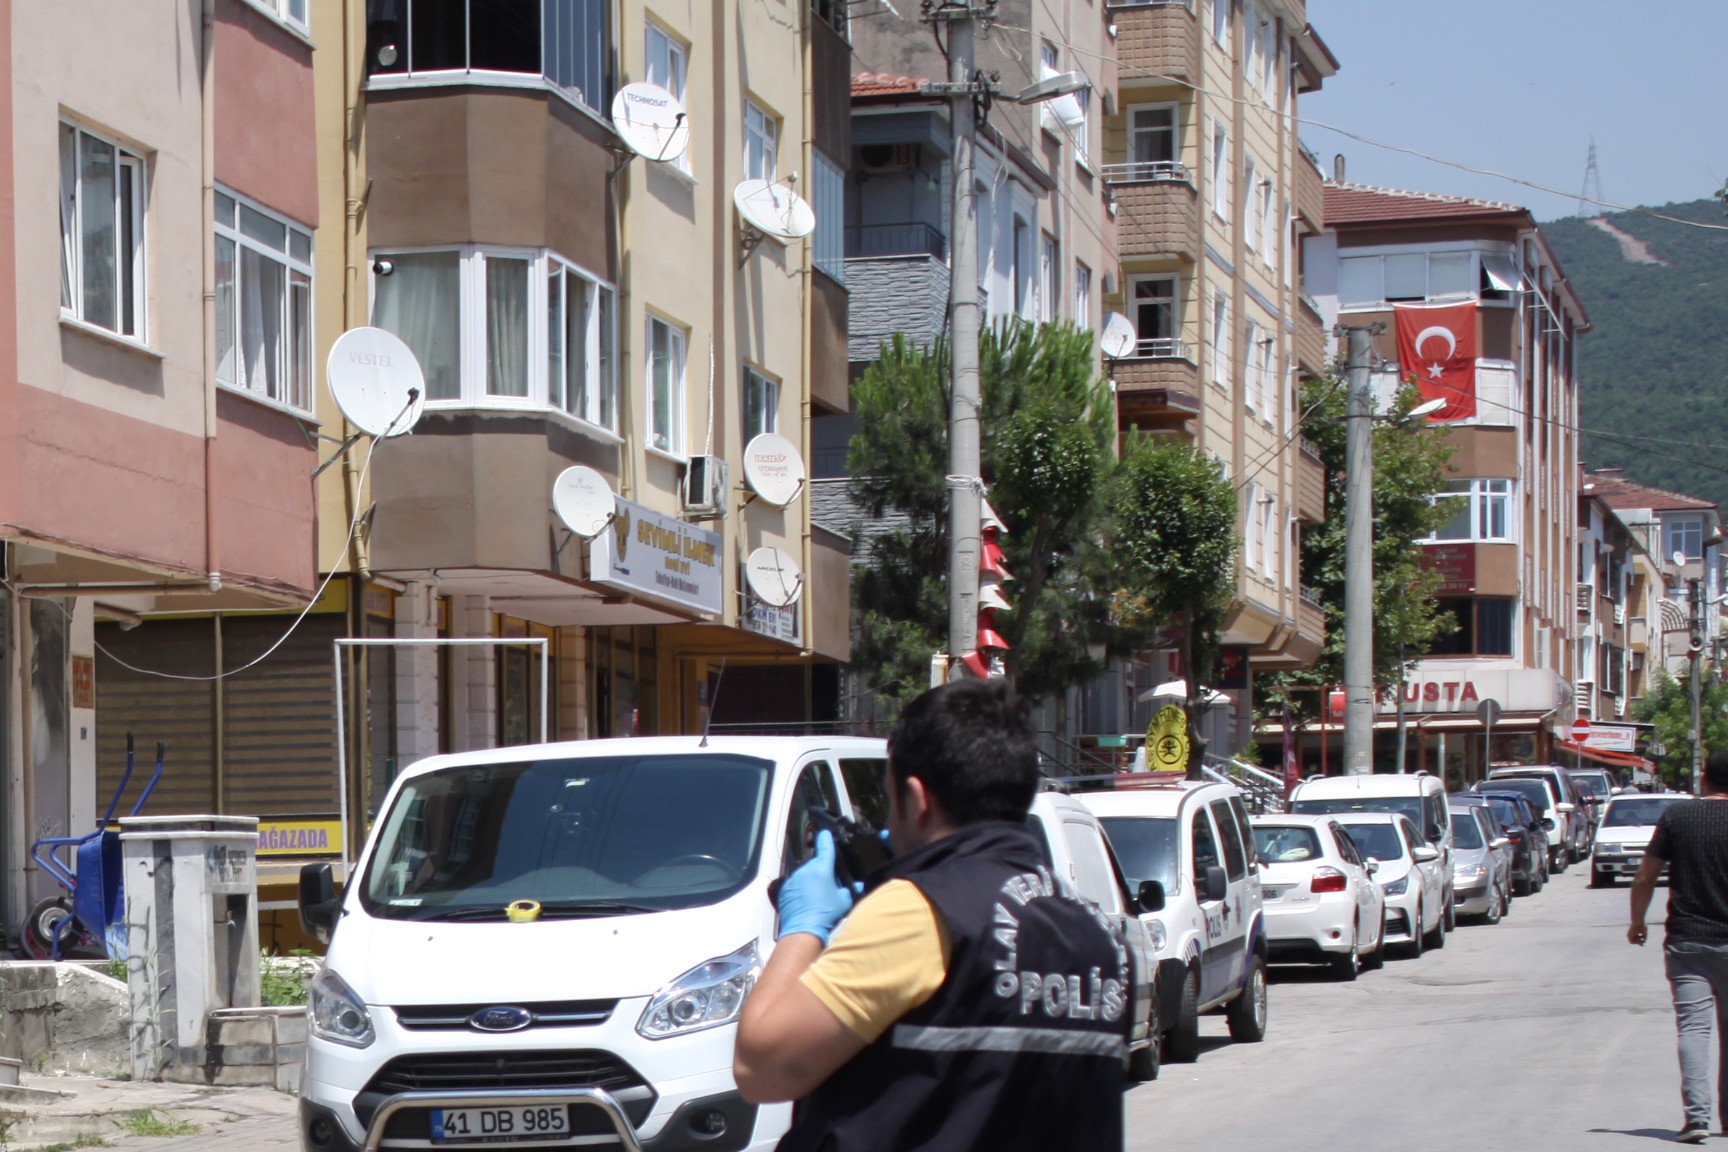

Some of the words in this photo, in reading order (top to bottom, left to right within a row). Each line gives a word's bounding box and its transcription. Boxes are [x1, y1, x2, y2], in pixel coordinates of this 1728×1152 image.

[627, 93, 668, 108] TECHNOSAT
[349, 351, 394, 368] VESTEL
[255, 826, 329, 849] AĞAZADA
[1020, 966, 1123, 1022] POLİS
[484, 1010, 515, 1025] Ford
[444, 1112, 470, 1134] 41
[480, 1110, 513, 1133] DB
[523, 1107, 564, 1131] 985
